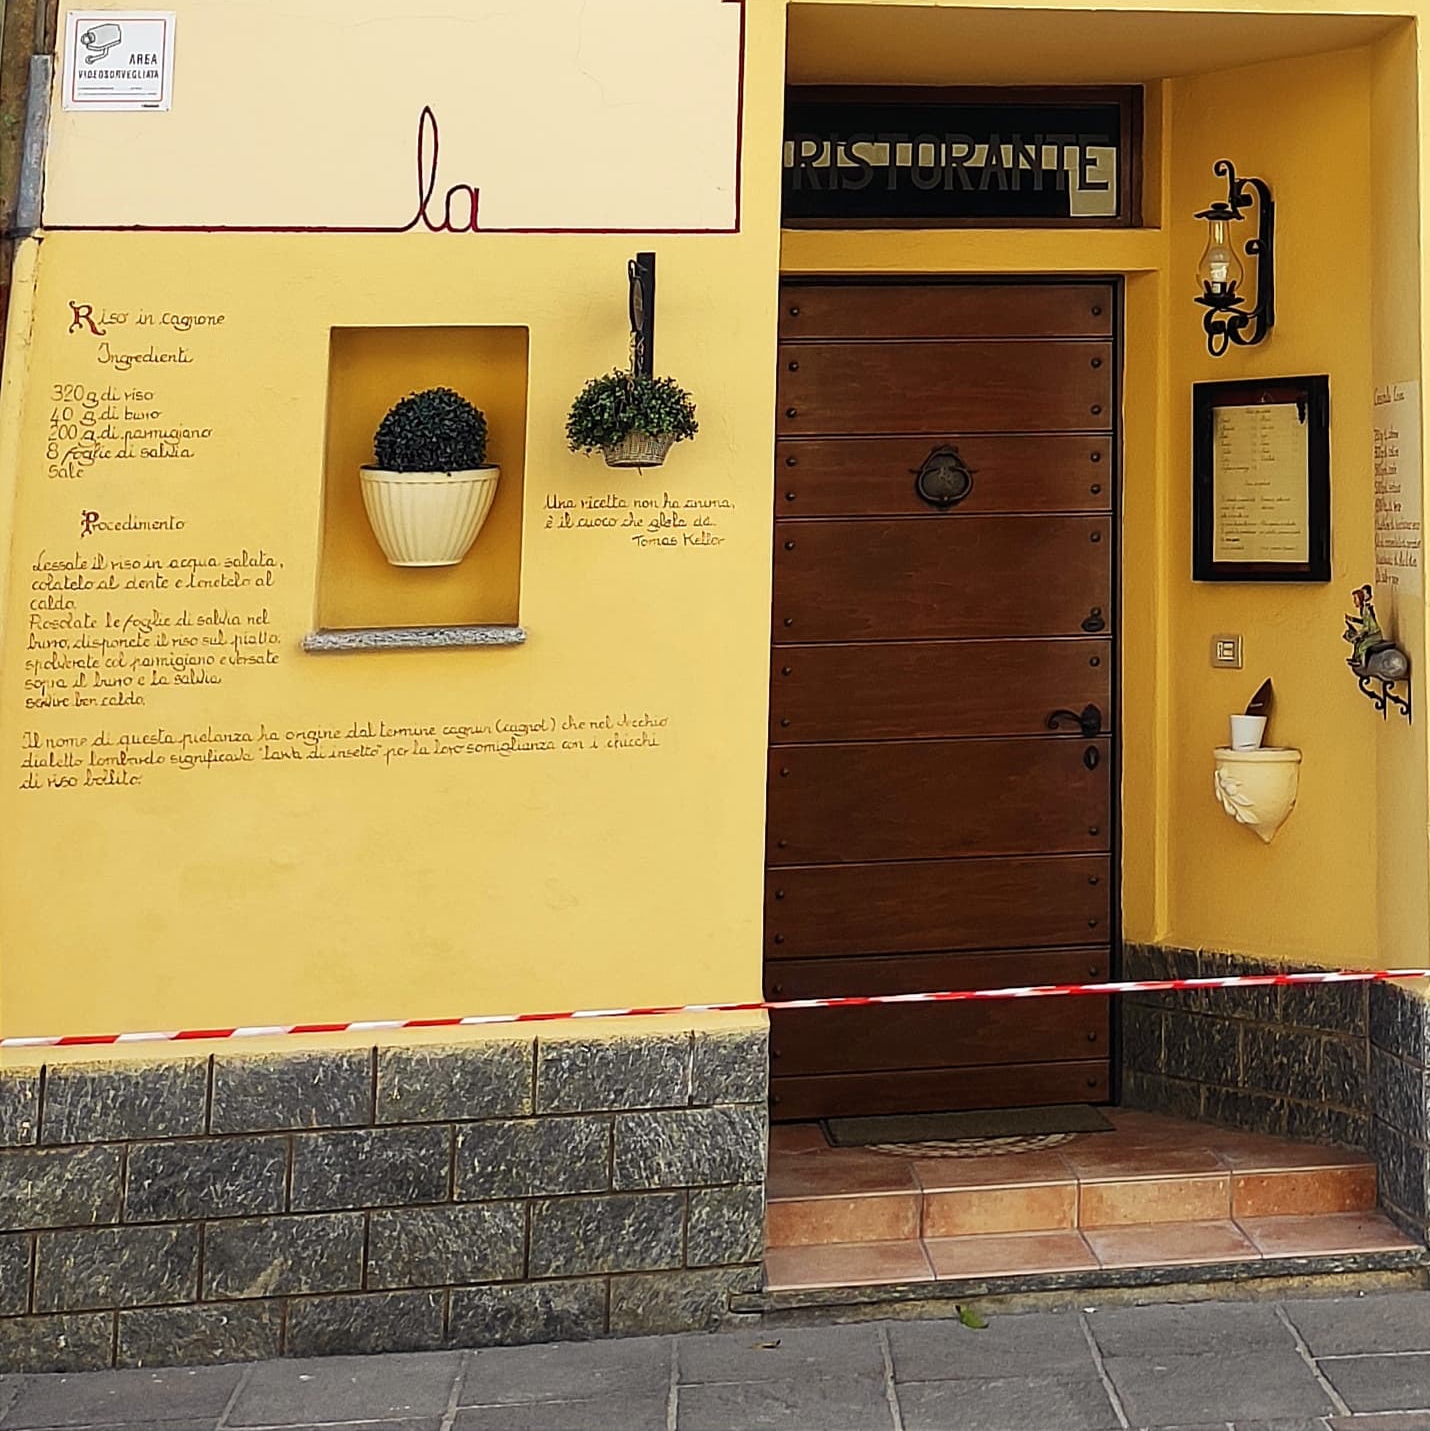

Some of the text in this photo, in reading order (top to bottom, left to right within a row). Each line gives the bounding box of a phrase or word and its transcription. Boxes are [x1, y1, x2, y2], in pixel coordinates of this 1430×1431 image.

[129, 54, 158, 65] AREA
[78, 70, 159, 79] VIDEOSORVEGLIATA
[400, 106, 480, 233] la
[793, 133, 1110, 192] RISTORANTE
[69, 301, 128, 335] Riso
[135, 308, 153, 325] in
[97, 342, 193, 370] Ingredienti
[101, 386, 154, 401] di riso
[98, 407, 119, 420] di
[121, 424, 212, 452] parmigiano
[46, 442, 58, 459] 8
[48, 462, 84, 479] Sale
[545, 494, 576, 509] Una
[581, 494, 628, 508] ricetta
[634, 499, 658, 508] non
[663, 492, 679, 508] ha
[81, 510, 186, 538] Procedimento
[621, 513, 643, 527] che
[632, 535, 677, 546] Tomas
[110, 556, 141, 569] riso
[169, 558, 218, 573] acqua
[126, 574, 169, 589] dente
[175, 611, 193, 626] di
[247, 609, 269, 625] nel
